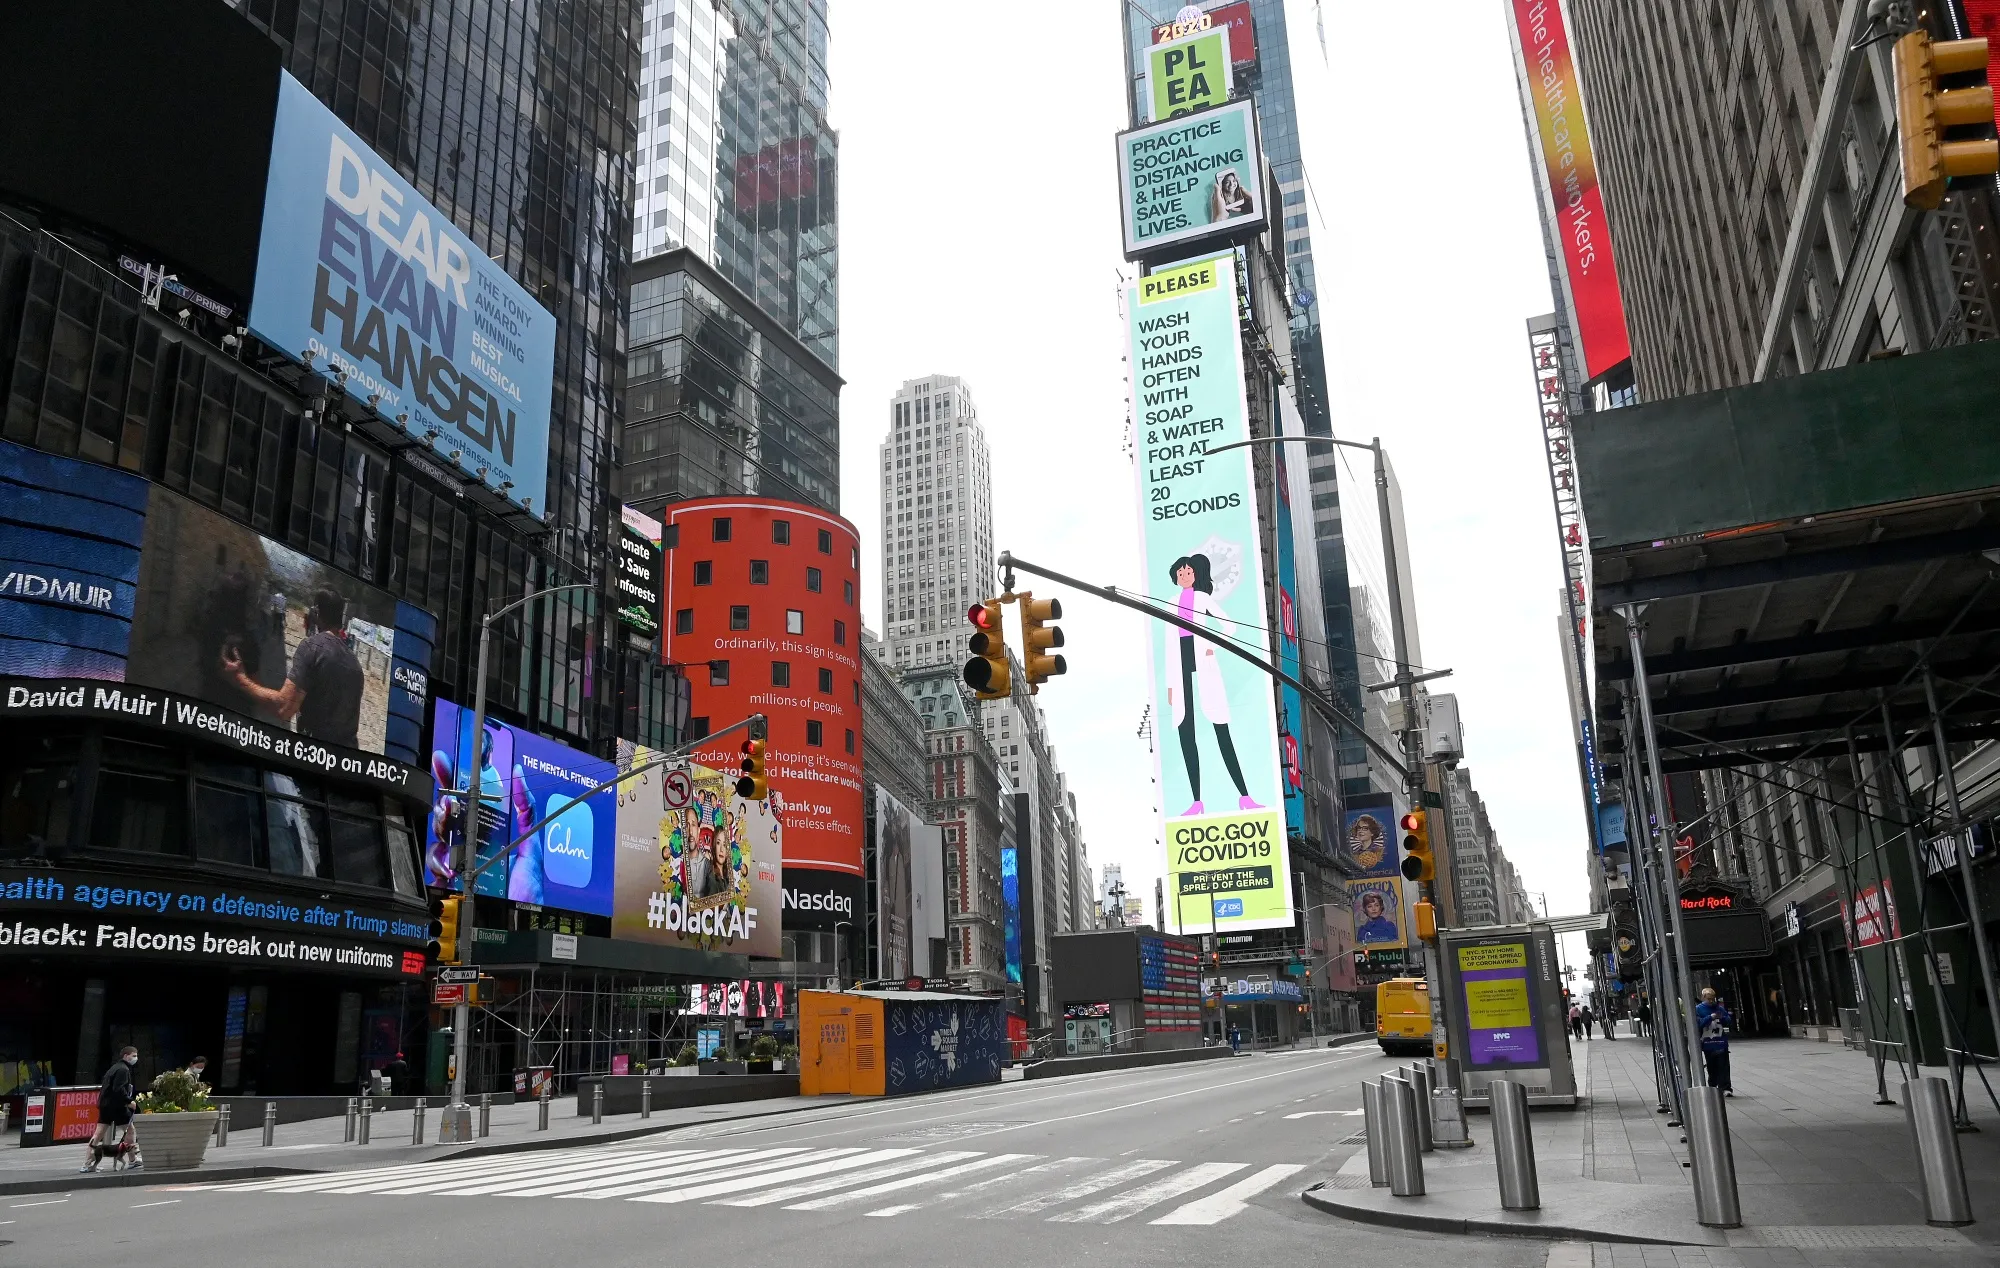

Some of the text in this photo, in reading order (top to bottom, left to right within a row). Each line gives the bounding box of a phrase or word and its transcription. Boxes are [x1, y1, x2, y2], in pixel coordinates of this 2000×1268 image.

[1158, 14, 1211, 42] 2020
[1164, 45, 1206, 76] PL
[1167, 72, 1211, 106] EA
[1132, 121, 1222, 156] PRACTICE
[1526, 11, 1596, 277] the healthcare workers.
[1132, 144, 1199, 172] SOCIAL
[1134, 149, 1244, 188] DISTANCING
[1135, 177, 1199, 205] & HELP
[325, 133, 470, 311] DEAR
[1136, 198, 1183, 221] SAVE
[1138, 214, 1192, 238] LIVES.
[123, 260, 228, 316] OUTFONT PRIME
[319, 197, 457, 361] EVAN
[1145, 270, 1210, 297] PLEASE
[477, 270, 532, 328] THE TONY
[475, 293, 522, 338] AWARD-
[1139, 311, 1190, 334] WASH
[471, 330, 504, 365] BEST
[473, 311, 525, 364] WINNING
[1140, 330, 1190, 351] YOUR
[311, 263, 516, 467] HANSEN
[1141, 345, 1203, 370] HANDS
[309, 338, 400, 407] ON BROADWAY
[470, 351, 522, 402] MUSICAL
[1143, 365, 1200, 388] OFTEN
[1144, 386, 1188, 407] WITH
[1145, 404, 1193, 425] SOAP
[1147, 418, 1224, 444] & WATER
[414, 410, 512, 483] DearEvanHansen.com
[1149, 439, 1210, 463] FOR AT
[1150, 460, 1205, 483] LEAST
[1151, 486, 1171, 502] 20
[1152, 493, 1241, 521] SECONDS
[621, 538, 650, 560] onate
[627, 558, 650, 580] Save
[617, 607, 658, 629] ainforestTrust.org
[715, 638, 779, 652] Ordinarily,
[782, 640, 803, 653] this
[805, 644, 825, 658] sign
[827, 647, 834, 659] is
[835, 653, 851, 666] seen
[750, 693, 844, 716] millions of people.
[7, 686, 409, 786] David Muir Weeknights at 6:30p on ABC-7
[523, 755, 598, 788] THE MENTAL FITNESS
[694, 751, 734, 762] Today,
[775, 752, 814, 767] hoping
[816, 753, 830, 766] it's
[831, 758, 848, 770] seen
[781, 766, 839, 784] Healthcare
[782, 801, 832, 815] hank you
[786, 817, 852, 835] tireless efforts.
[1175, 821, 1269, 846] CDC.GOV
[547, 822, 590, 860] Calm
[1177, 840, 1271, 865] /COVID19
[1236, 871, 1254, 879] THE
[1236, 877, 1269, 887] GERMS
[74, 884, 421, 937] agency on defensive after Trump slams
[648, 892, 758, 939] #blackAF
[782, 888, 852, 919] Nasdaq
[1680, 896, 1731, 909] Hard Rock
[96, 925, 196, 952] Falcons
[203, 931, 261, 957] break
[267, 940, 295, 959] out
[299, 944, 331, 963] new
[336, 946, 393, 968] uniforms
[478, 930, 506, 944] Broadway
[1378, 952, 1403, 961] hulu
[1539, 939, 1551, 981] Newsstand
[443, 971, 456, 979] ONE
[1493, 1032, 1510, 1040] NYC
[76, 1109, 90, 1118] THE
[60, 1123, 97, 1138] ABSUR
